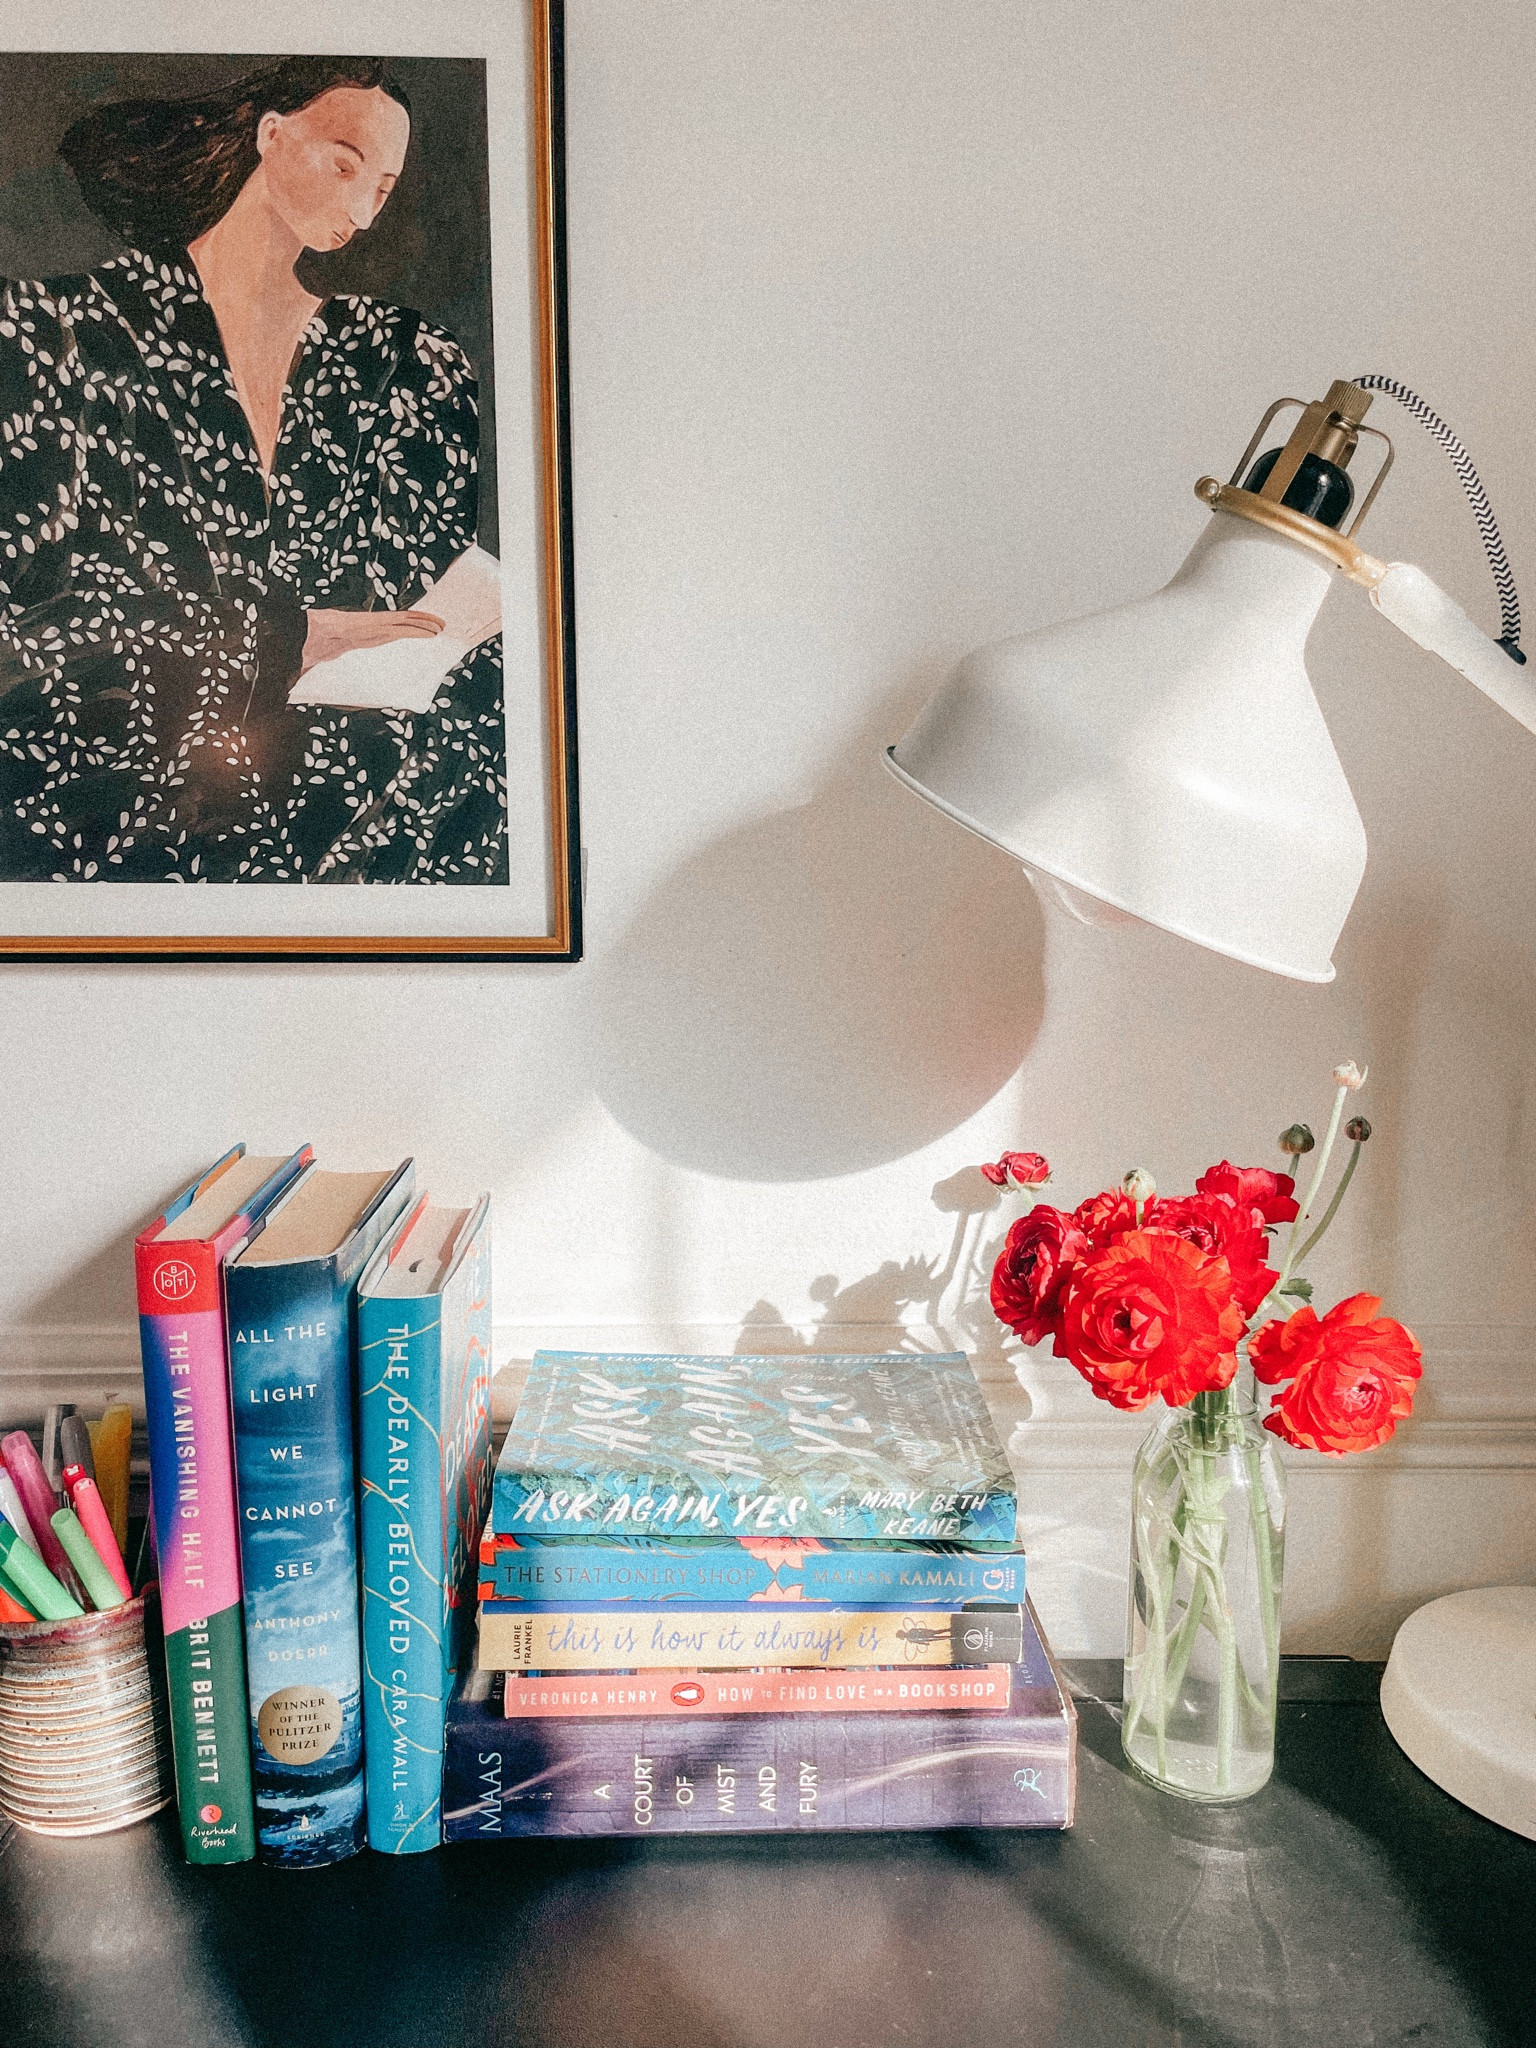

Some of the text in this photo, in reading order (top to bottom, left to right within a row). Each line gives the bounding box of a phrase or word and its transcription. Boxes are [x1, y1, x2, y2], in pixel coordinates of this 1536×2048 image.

[235, 1323, 327, 1344] ALL THE
[250, 1383, 317, 1404] LIGHT
[567, 1372, 652, 1455] ASK
[673, 1362, 771, 1481] AGAIN,
[780, 1385, 881, 1459] YES
[168, 1331, 204, 1589] THE VANISHING HALF
[270, 1445, 302, 1461] WE
[388, 1323, 410, 1654] THE DEARLY BELOVED
[245, 1499, 337, 1521] CANNOT
[513, 1488, 599, 1523] ASK
[602, 1493, 721, 1528] AGAIN,
[733, 1494, 807, 1529] YES
[859, 1490, 989, 1512] MARY BETH
[883, 1517, 960, 1536] KEANE
[275, 1561, 314, 1578] SEE
[504, 1566, 755, 1585] THE STATIONERY SHOP
[812, 1570, 975, 1587] MARIAN KAMALI
[254, 1610, 340, 1629] ANTHONY
[514, 1624, 522, 1660] LAURIE
[524, 1619, 533, 1664] FRANKEL
[546, 1618, 882, 1662] this is how it always is
[268, 1644, 328, 1662] DOERR
[188, 1617, 219, 1784] BRIT BENNETT
[519, 1689, 657, 1706] VERONICA HENRY
[718, 1683, 995, 1701] HOW TO FIND LOVE IN A BOOKSHOP
[272, 1697, 326, 1711] WINNER
[279, 1712, 319, 1724] OF THE
[269, 1723, 331, 1737] PULITZER
[392, 1669, 408, 1791] CARA WALL
[282, 1739, 319, 1751] PRIZE
[478, 1752, 502, 1833] MAAS
[593, 1784, 611, 1799] A
[634, 1753, 653, 1825] COURT
[676, 1775, 694, 1805] OF
[717, 1764, 736, 1814] MIST
[758, 1766, 777, 1812] AND
[799, 1762, 818, 1813] FURY
[191, 1822, 237, 1837] Riverhead
[202, 1837, 226, 1849] Books
